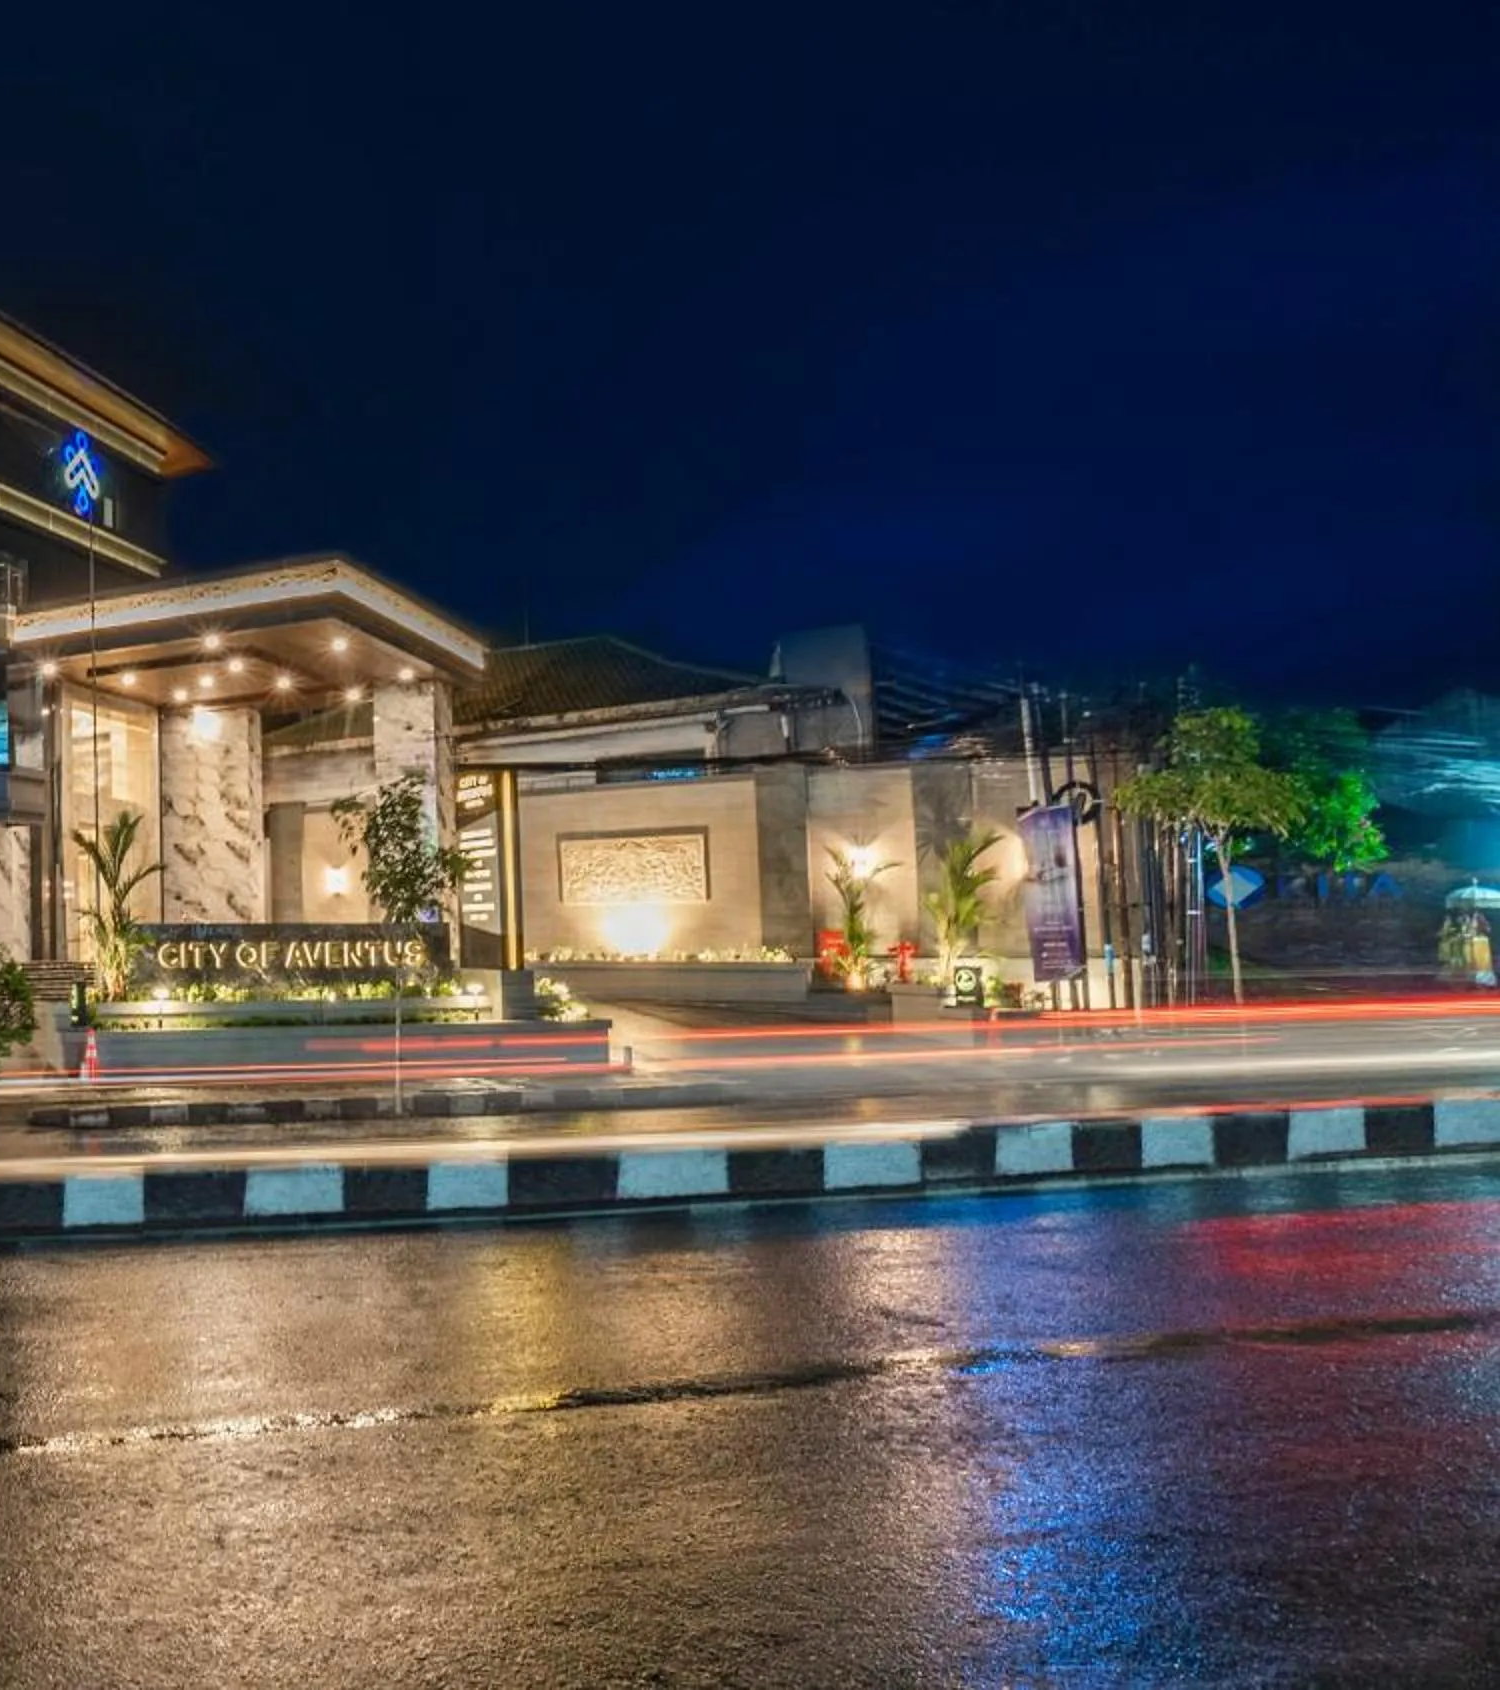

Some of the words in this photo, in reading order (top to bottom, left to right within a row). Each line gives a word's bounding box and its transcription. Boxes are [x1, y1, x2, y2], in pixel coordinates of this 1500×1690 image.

[157, 941, 227, 969] CITY
[235, 941, 280, 969] OF
[284, 941, 423, 969] AVENTUS
